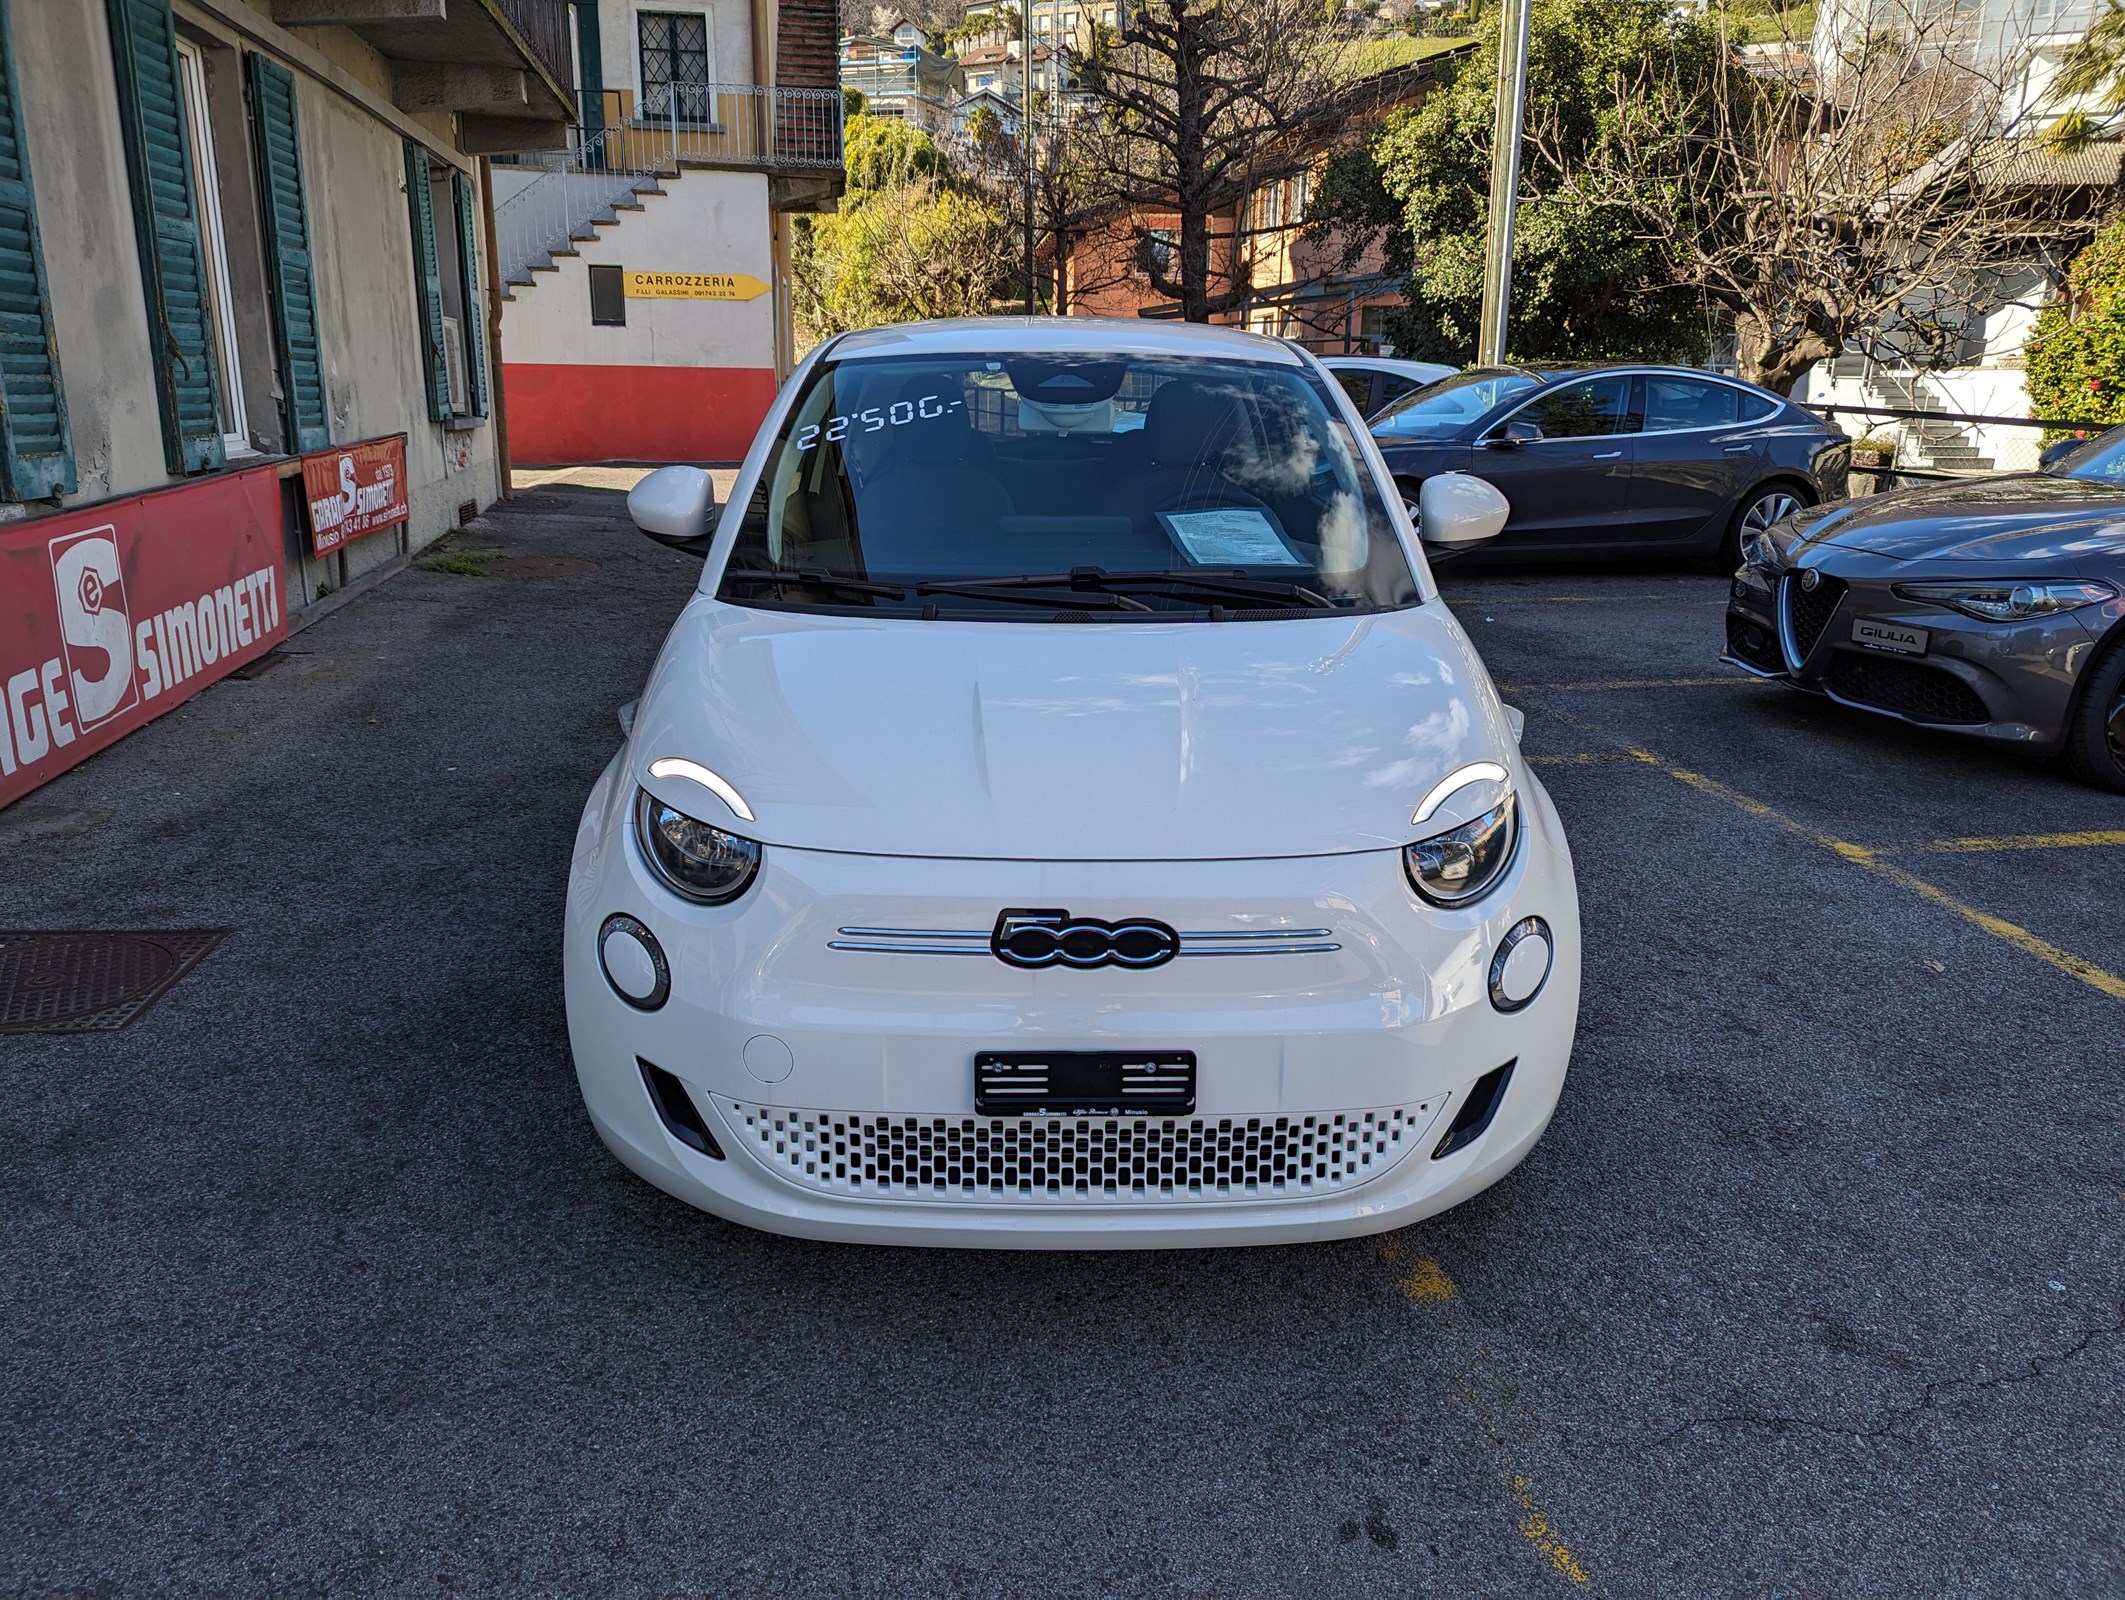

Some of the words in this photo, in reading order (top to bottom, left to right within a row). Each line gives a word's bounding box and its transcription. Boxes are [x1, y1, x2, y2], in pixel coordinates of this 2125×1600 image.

[635, 274, 735, 288] CARROZZERIA
[356, 478, 394, 515] SIMONETTI
[135, 565, 280, 702] SIMONETTI
[1860, 626, 1917, 645] GIULIA
[995, 911, 1176, 966] 500
